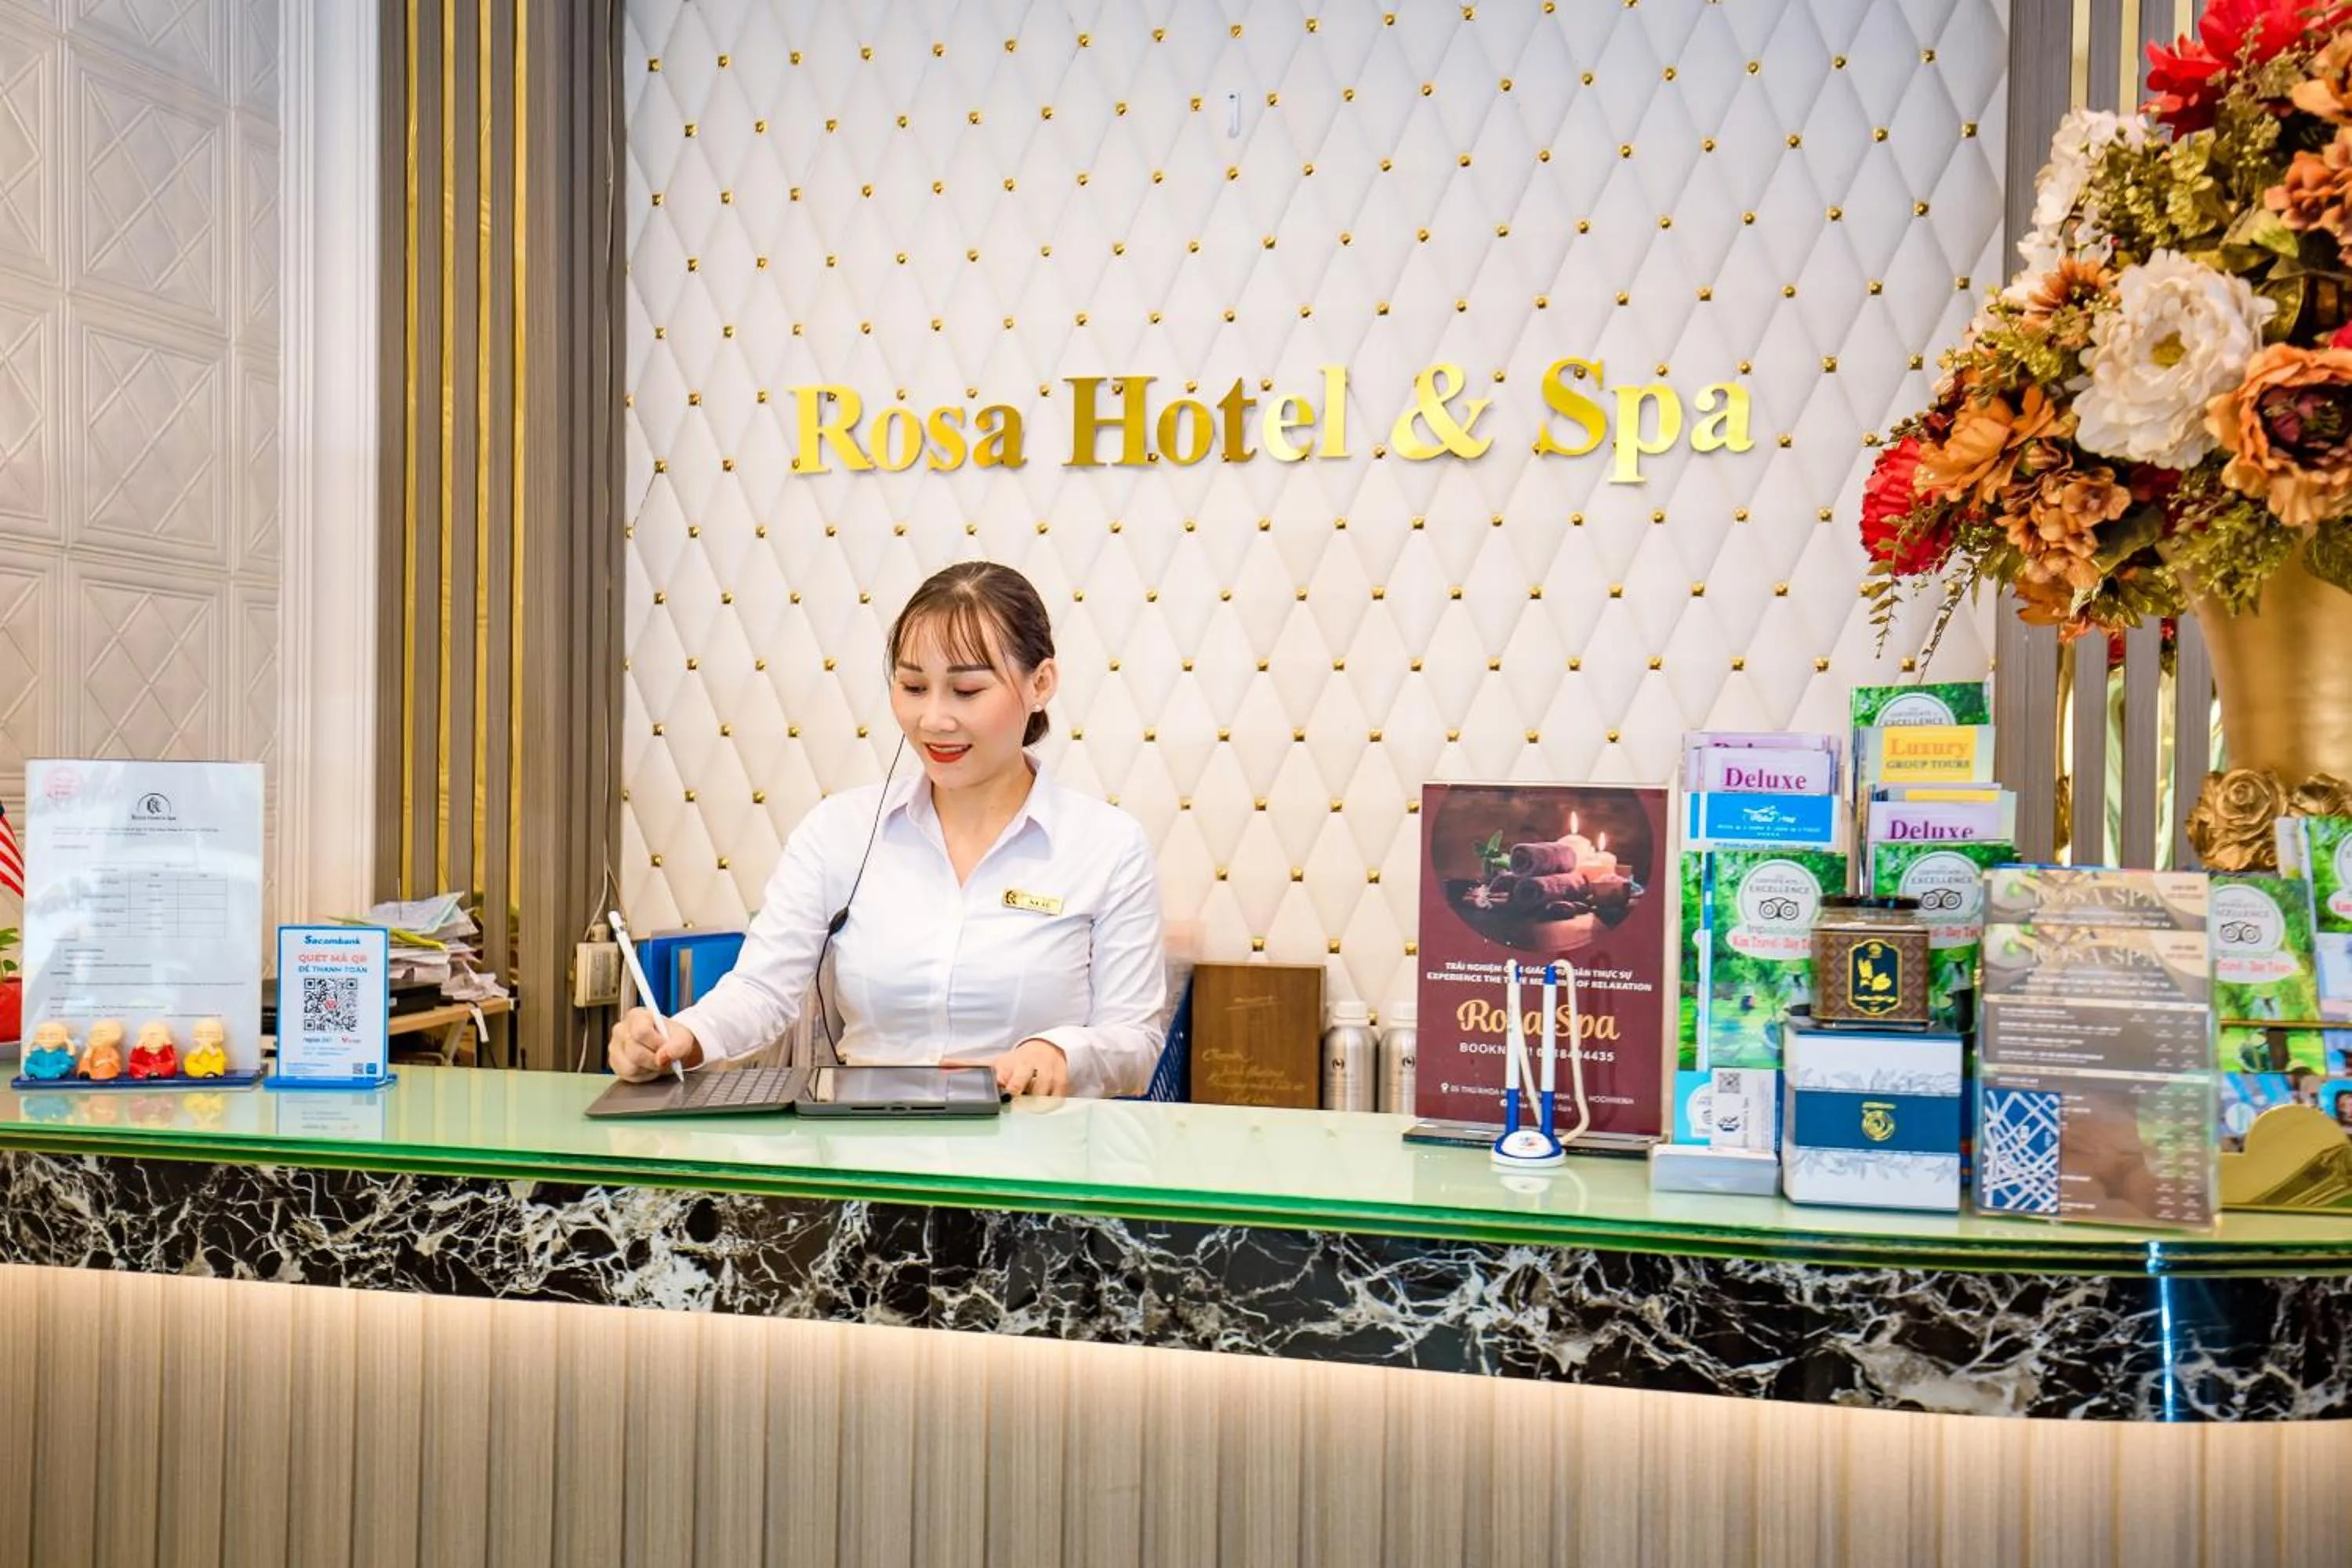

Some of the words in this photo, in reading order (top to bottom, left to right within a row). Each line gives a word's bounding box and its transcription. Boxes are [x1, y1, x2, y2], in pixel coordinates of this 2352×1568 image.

[789, 383, 1027, 474] Rosa
[1062, 364, 1352, 466] Hotel
[1390, 363, 1494, 461] &
[1537, 356, 1755, 484] Spa
[1889, 737, 1970, 760] Luxury
[1886, 759, 1928, 769] GROUP
[1931, 759, 1970, 769] TOURS
[1725, 767, 1807, 789] Deluxe
[1889, 819, 1974, 840] Deluxe
[1749, 884, 1809, 895] EXCELLENCE
[1911, 876, 1973, 885] EXCELLENCE
[304, 935, 361, 945] Sacombank
[1426, 971, 1482, 983] EXPERIENCE
[1483, 975, 1501, 984] THE
[1577, 979, 1590, 989] OF
[1592, 980, 1653, 992] RELAXATION
[1457, 998, 1543, 1033] Roa
[1555, 1004, 1622, 1040] Spa
